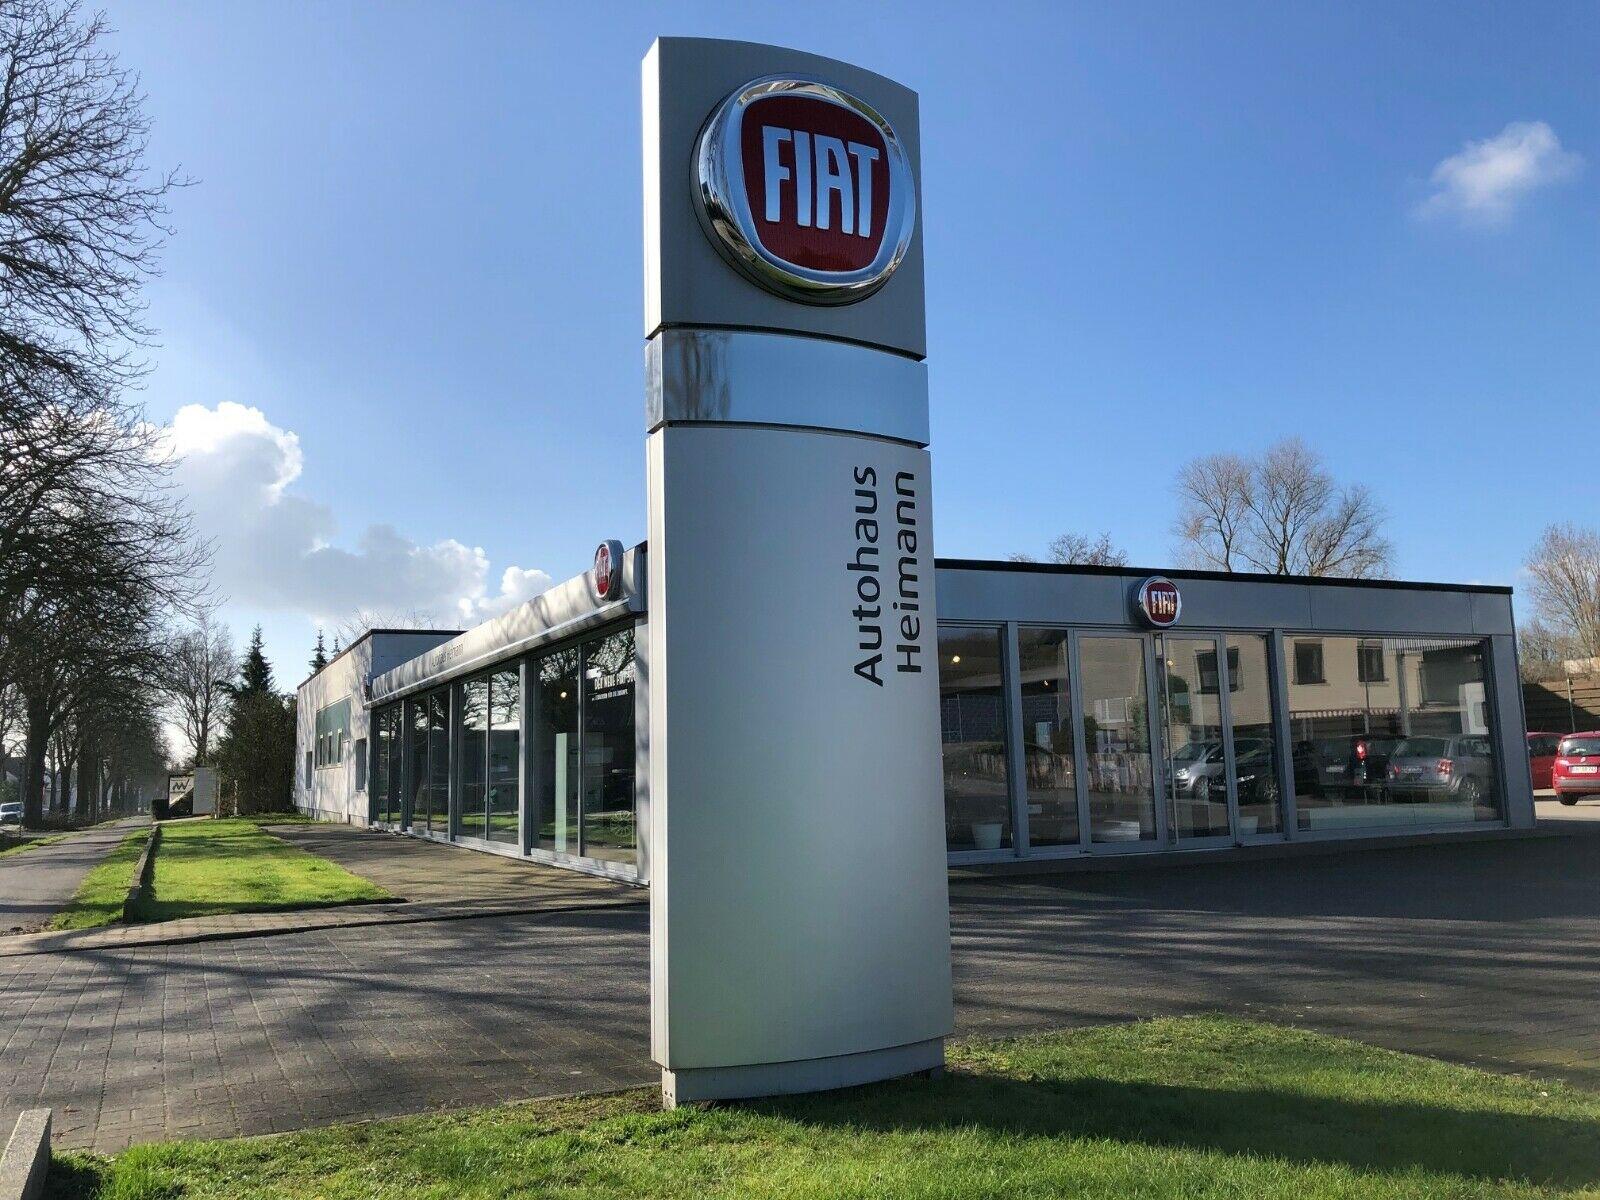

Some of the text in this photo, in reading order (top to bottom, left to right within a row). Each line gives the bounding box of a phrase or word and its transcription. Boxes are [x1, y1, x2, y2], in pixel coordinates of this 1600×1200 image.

[762, 125, 879, 238] FIAT
[846, 466, 884, 687] Autohaus
[892, 471, 922, 673] Heimann
[1151, 590, 1175, 614] FIAT
